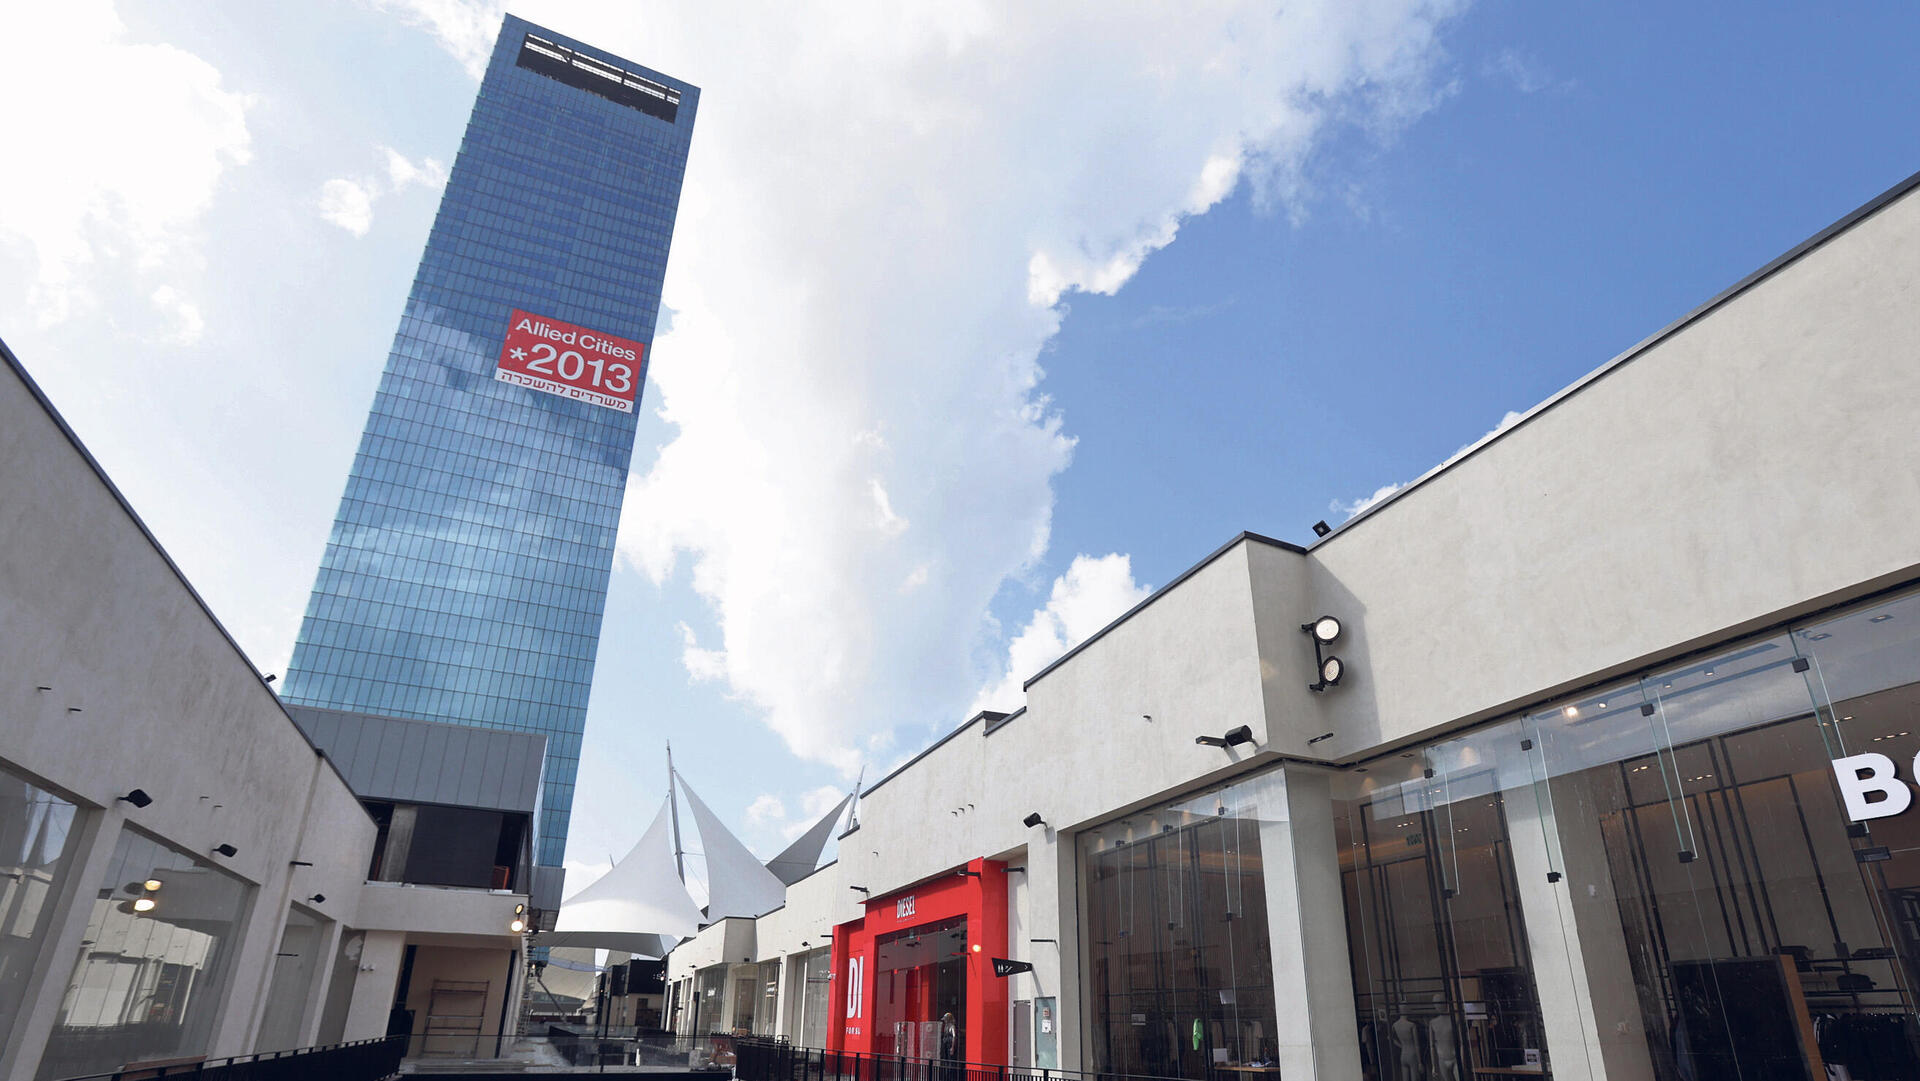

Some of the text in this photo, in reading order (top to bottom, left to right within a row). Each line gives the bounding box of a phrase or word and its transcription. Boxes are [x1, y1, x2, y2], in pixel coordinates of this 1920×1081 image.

[516, 318, 636, 361] Allied Cities
[501, 371, 627, 410] משרדים להשכרה
[897, 896, 915, 919] DIESEL
[847, 956, 864, 1019] DI
